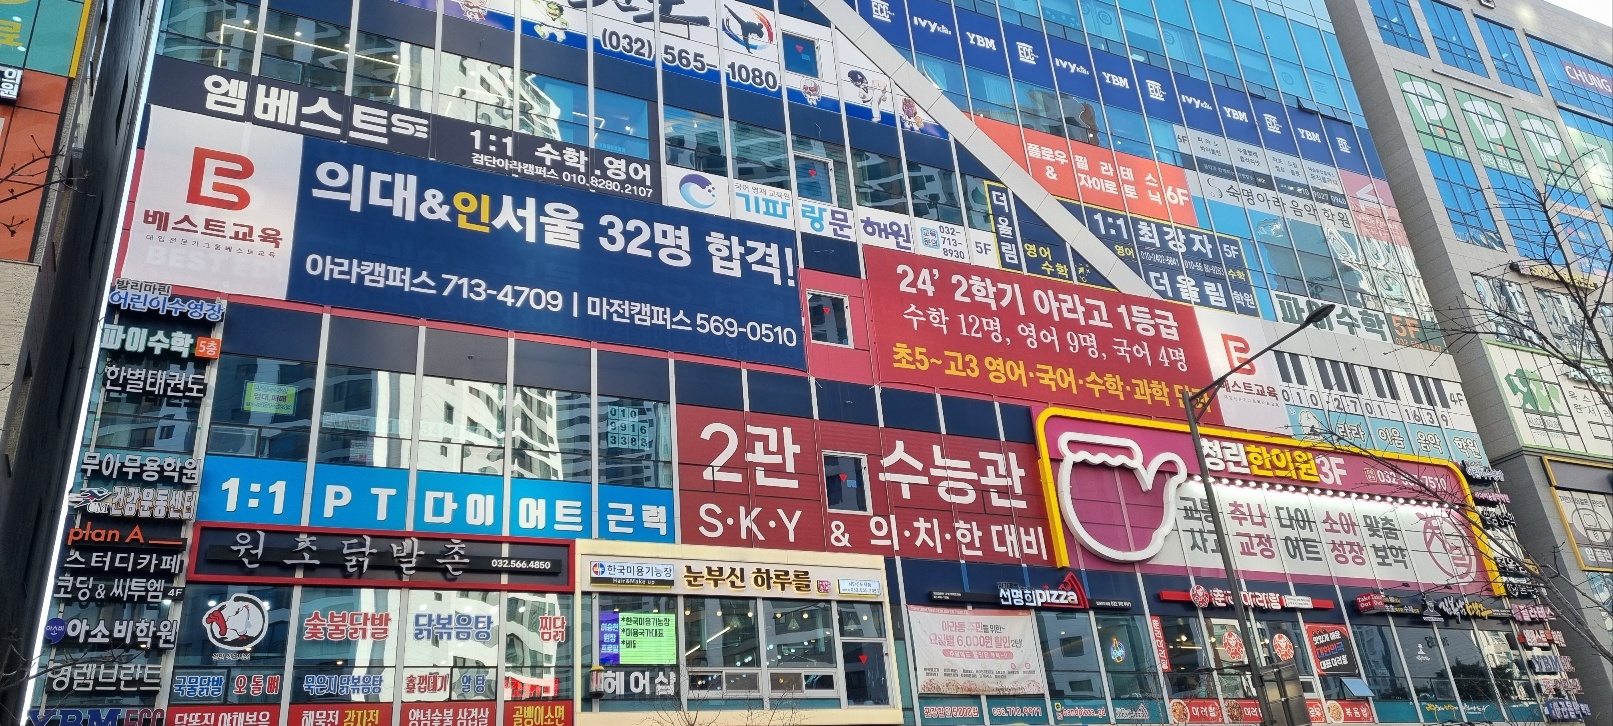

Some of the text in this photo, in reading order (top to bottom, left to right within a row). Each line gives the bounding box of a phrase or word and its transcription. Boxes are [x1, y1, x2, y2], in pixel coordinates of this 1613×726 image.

[601, 27, 653, 60] (032)
[966, 31, 996, 50] YBM
[1102, 71, 1129, 89] YBM
[1223, 106, 1249, 123] YBM
[470, 129, 514, 157] 1:1
[1297, 127, 1321, 143] YBM
[1026, 142, 1069, 165] 플로우
[1454, 145, 1465, 157] 7F
[471, 152, 653, 198] 검단아라캠퍼스 010.8280.2107
[1045, 165, 1058, 181] &
[1074, 154, 1159, 187] 필라테스
[1078, 173, 1163, 205] 자이로토닉
[1166, 186, 1190, 206] 6F
[1226, 184, 1351, 228] 숙명아라 음악 학원
[143, 209, 283, 248] 베스트교육
[311, 161, 796, 287] 의대&인서울 32명 합격!
[939, 225, 961, 236] 032-
[1094, 212, 1240, 259] 1:1 최강자 5F
[941, 236, 963, 247] 713-
[943, 248, 965, 259] 8930
[975, 241, 992, 255] 5F
[1024, 243, 1052, 261] 영어
[1041, 261, 1068, 278] 수학
[1114, 244, 1246, 281] 영어 수학
[116, 278, 172, 297] 발리마린
[305, 253, 437, 295] 아라캠퍼스
[441, 274, 563, 312] 713-4709
[587, 295, 693, 331] 마전캠퍼스
[696, 313, 797, 347] 569-0510
[1233, 290, 1256, 308] 학원
[109, 290, 225, 322] 어린이수영장
[951, 274, 1026, 316] 2학기
[1033, 289, 1114, 329] 아라고
[1117, 303, 1180, 341] 1등급
[101, 323, 194, 358] 파이수학
[903, 303, 1188, 373] 수학 12명, 영어 9명, 국어 4명
[1391, 315, 1420, 339] 5F
[199, 340, 219, 356] 5층
[892, 342, 980, 378] 초5~고3
[105, 364, 205, 398] 한별태권도
[609, 406, 638, 421] 010
[1449, 392, 1464, 407] 4F
[608, 421, 648, 436] 9916
[608, 434, 648, 450] 3388
[700, 422, 801, 489] 2관
[1416, 430, 1444, 454] 음악
[1453, 435, 1483, 459] 학원
[81, 452, 199, 485] 무아무용학원
[878, 440, 1028, 509] 수능관
[1316, 456, 1348, 486] 3F
[110, 486, 198, 520] 건강운동센터
[221, 477, 286, 515] 1:1
[424, 491, 583, 533] 다이어트
[607, 502, 667, 536] 근력
[67, 521, 145, 546] plan A
[1228, 501, 1267, 528] 추나
[1275, 505, 1314, 532] 다이
[1322, 510, 1357, 536] 소아
[1363, 514, 1399, 541] 맞춤
[830, 520, 852, 547] &
[990, 524, 1048, 561] 대비
[1236, 531, 1275, 559] 교정
[1284, 535, 1323, 561] 어트
[1331, 540, 1366, 566] 성장
[1369, 544, 1408, 570] 보약
[63, 551, 183, 576] 스터디카페
[491, 558, 551, 570] 032.566.4850
[607, 564, 673, 578] 한국미용기능장
[53, 575, 93, 601] 코딩
[95, 583, 106, 599] &
[168, 588, 183, 597] 4F
[683, 564, 746, 591] 눈부신
[750, 567, 813, 593] 하루를
[67, 618, 178, 649] 아소비학원
[304, 610, 391, 642] 숯불닭발
[413, 613, 494, 642] 닭볶음탕
[539, 615, 566, 642] 찜닭
[173, 676, 224, 697] 국물닭발
